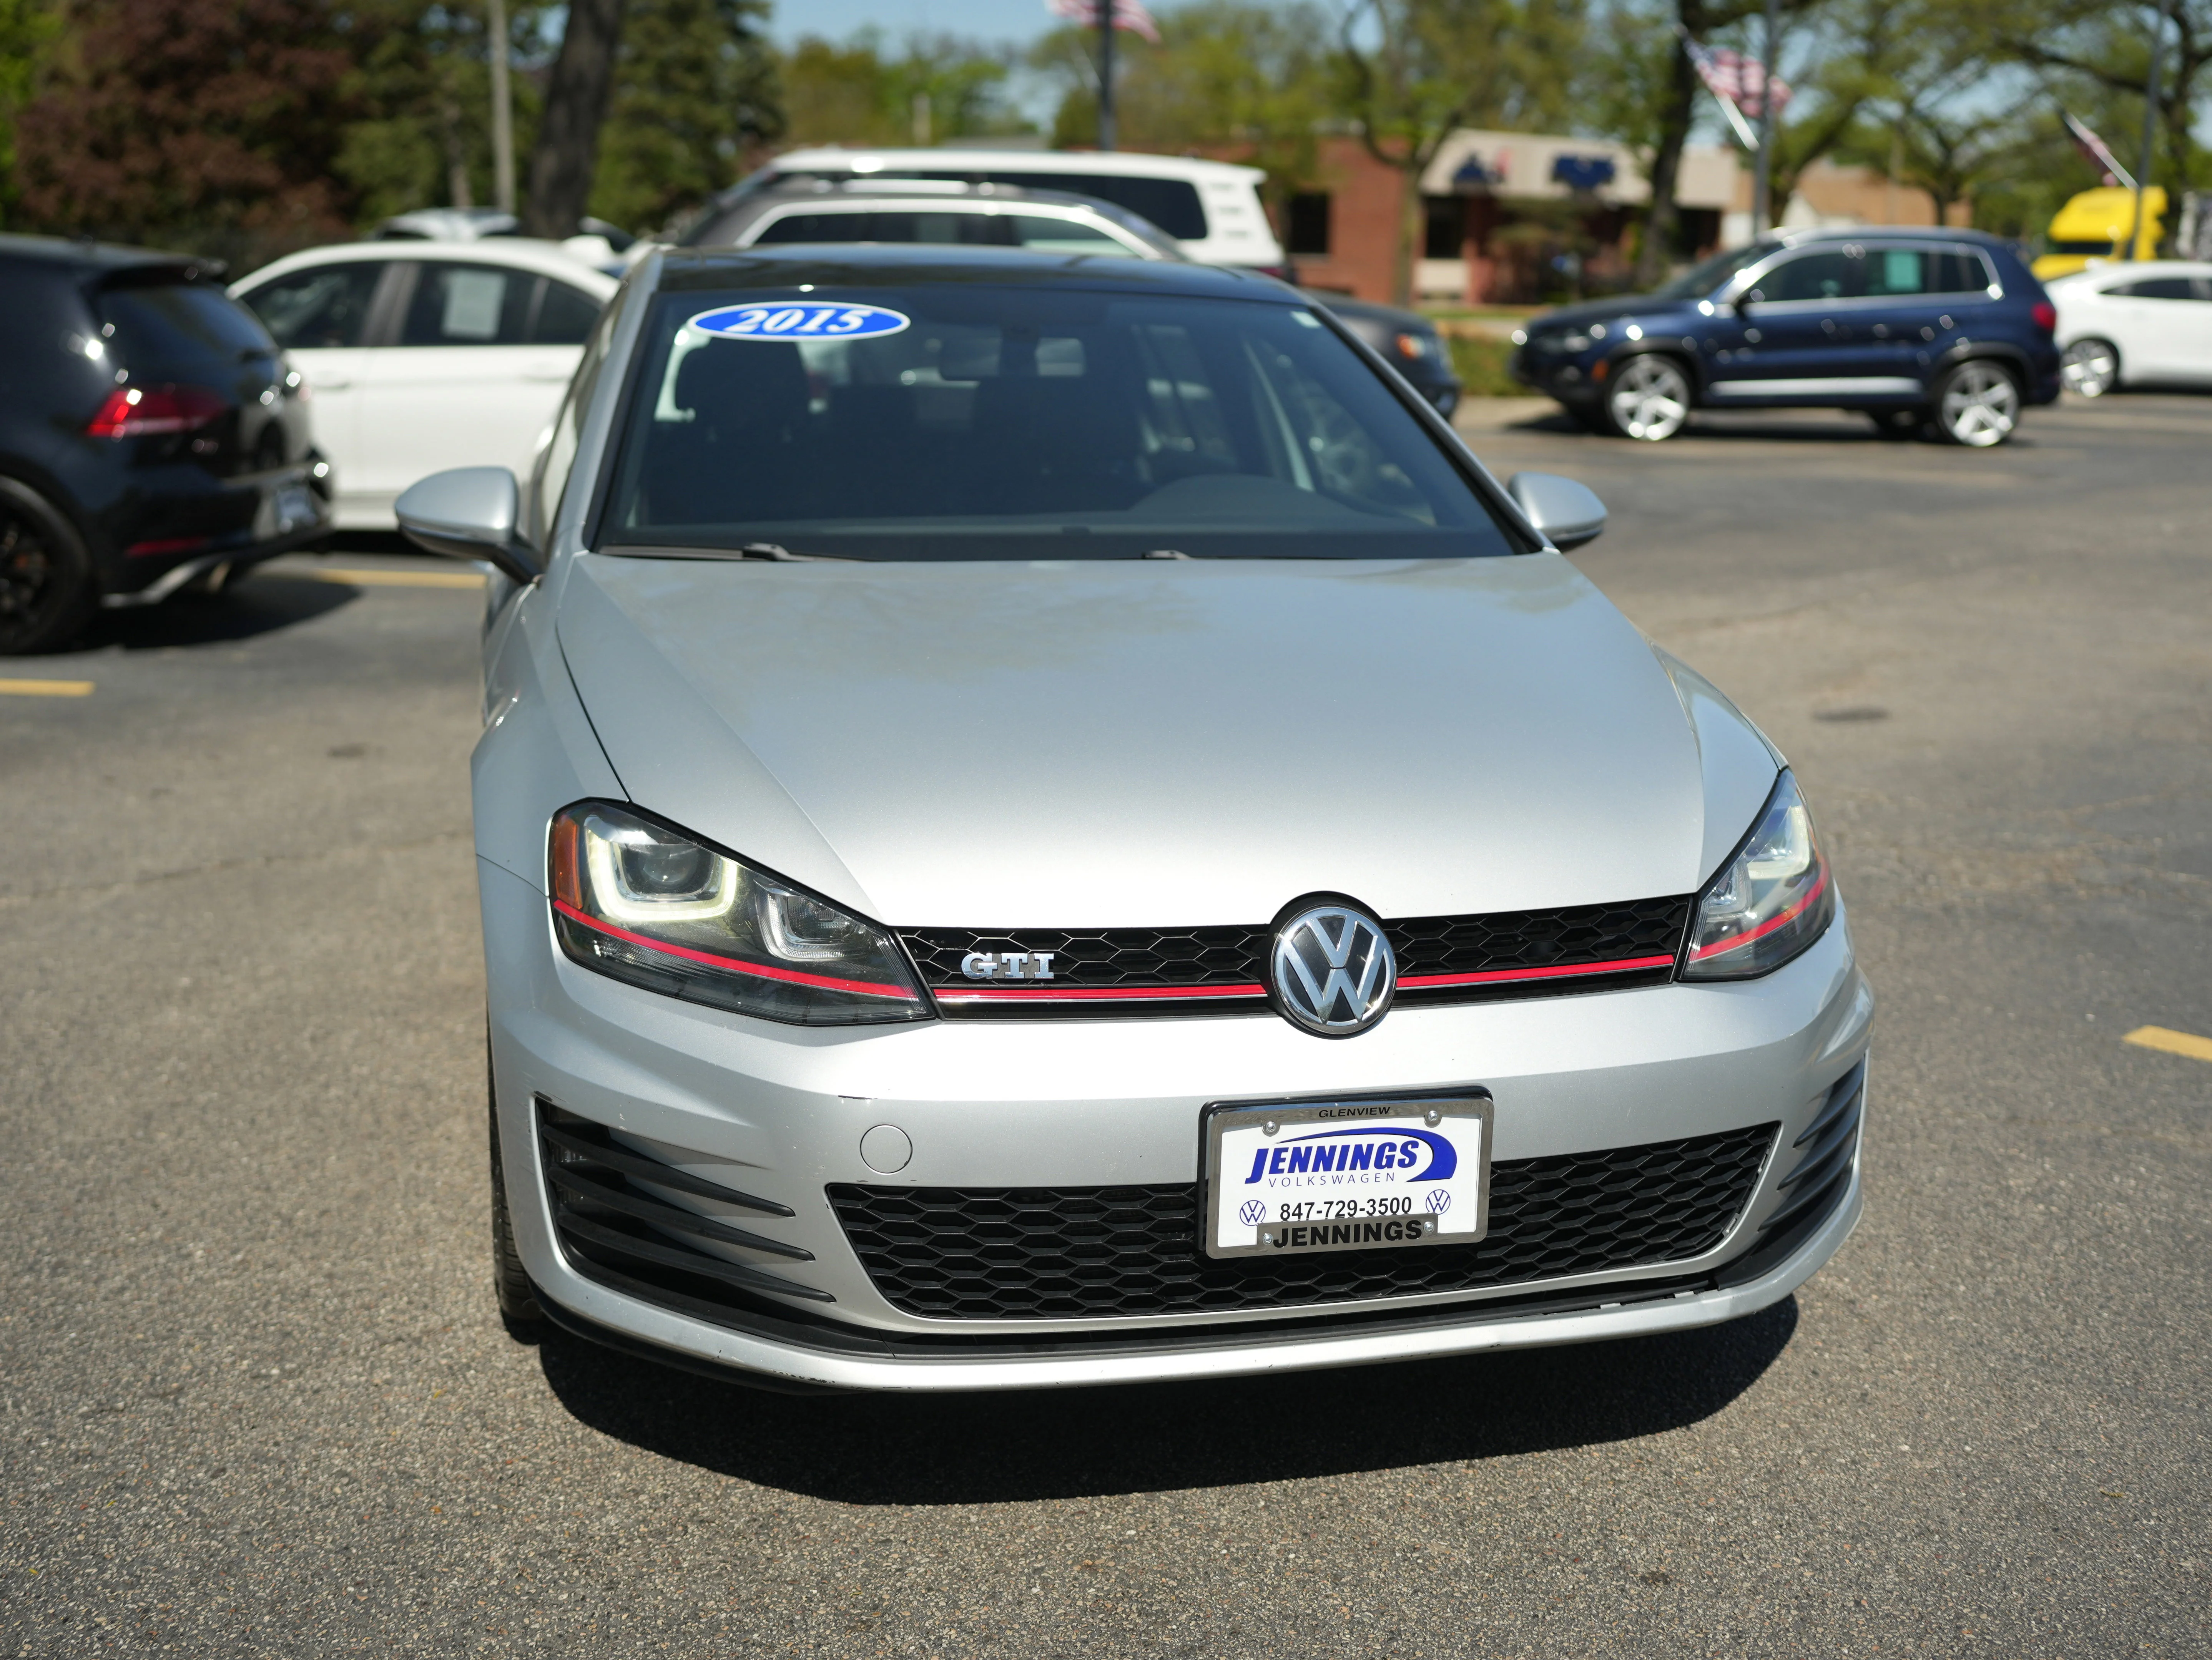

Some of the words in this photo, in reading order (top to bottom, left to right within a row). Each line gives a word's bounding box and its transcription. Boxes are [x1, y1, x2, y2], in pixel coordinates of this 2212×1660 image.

[723, 308, 874, 333] 2015
[961, 953, 1054, 979] GTI
[1318, 1106, 1391, 1118] GLENVIEW
[1245, 1140, 1419, 1184] JENNINGS
[1268, 1172, 1394, 1187] VOLKSWAGEN
[1280, 1196, 1412, 1220] 847-729-3500
[1273, 1220, 1422, 1248] JENNINGS
